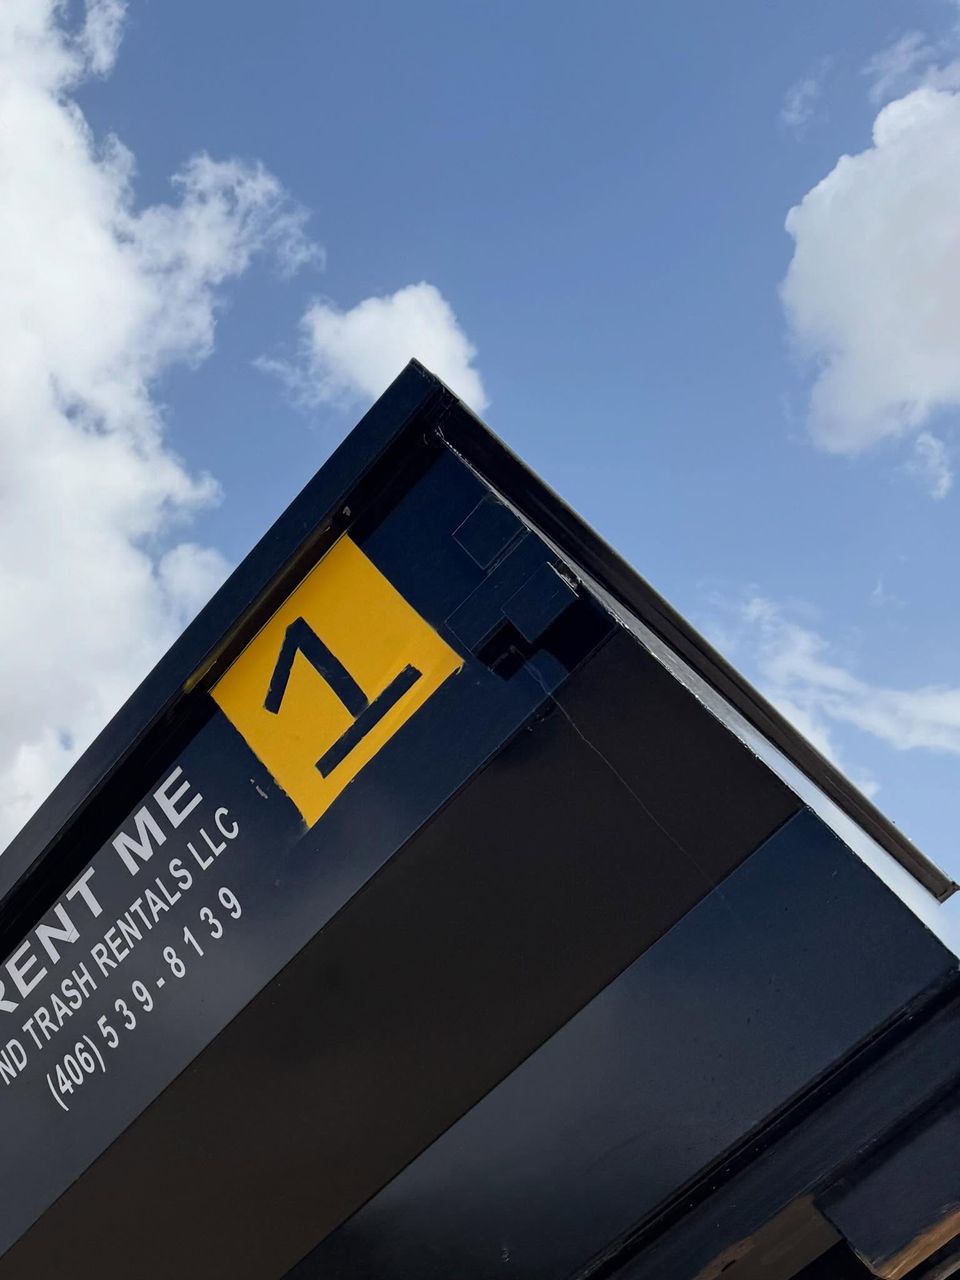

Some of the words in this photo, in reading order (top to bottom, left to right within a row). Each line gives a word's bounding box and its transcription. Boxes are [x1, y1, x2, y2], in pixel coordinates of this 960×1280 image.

[264, 617, 423, 779] 1
[112, 766, 202, 876] ME
[22, 962, 97, 1049] TRASH
[91, 859, 192, 978] RENTALS
[187, 808, 238, 870] LLC
[47, 1035, 105, 1111] (406)
